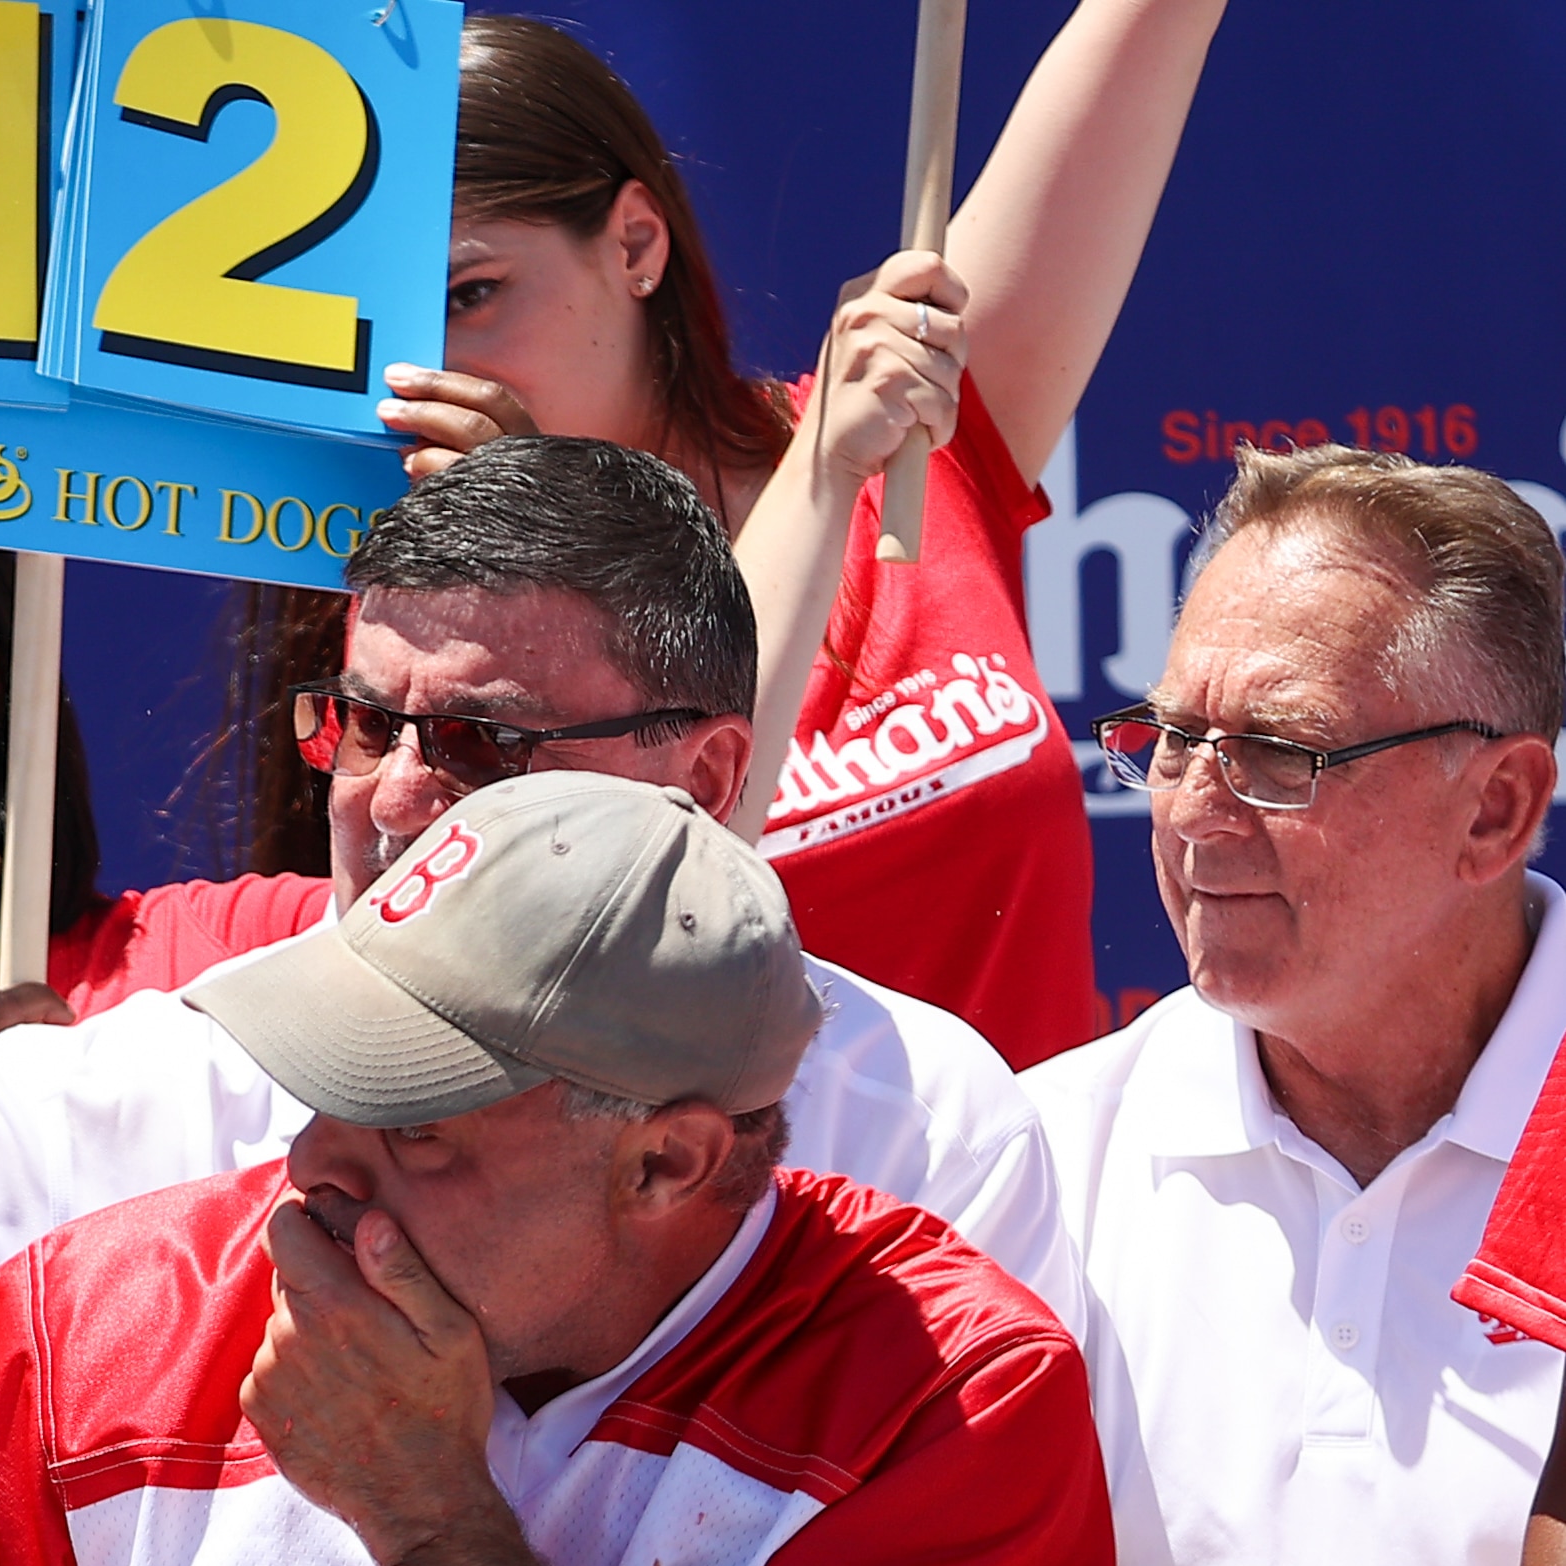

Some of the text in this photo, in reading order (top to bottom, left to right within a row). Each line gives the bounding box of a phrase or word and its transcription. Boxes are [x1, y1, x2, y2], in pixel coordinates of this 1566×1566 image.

[1346, 403, 1479, 457] 1916
[53, 467, 197, 537] HOT
[217, 488, 386, 559] DOG
[896, 668, 937, 698] 1916
[768, 652, 1047, 818] than's
[799, 780, 946, 841] FAMOUS
